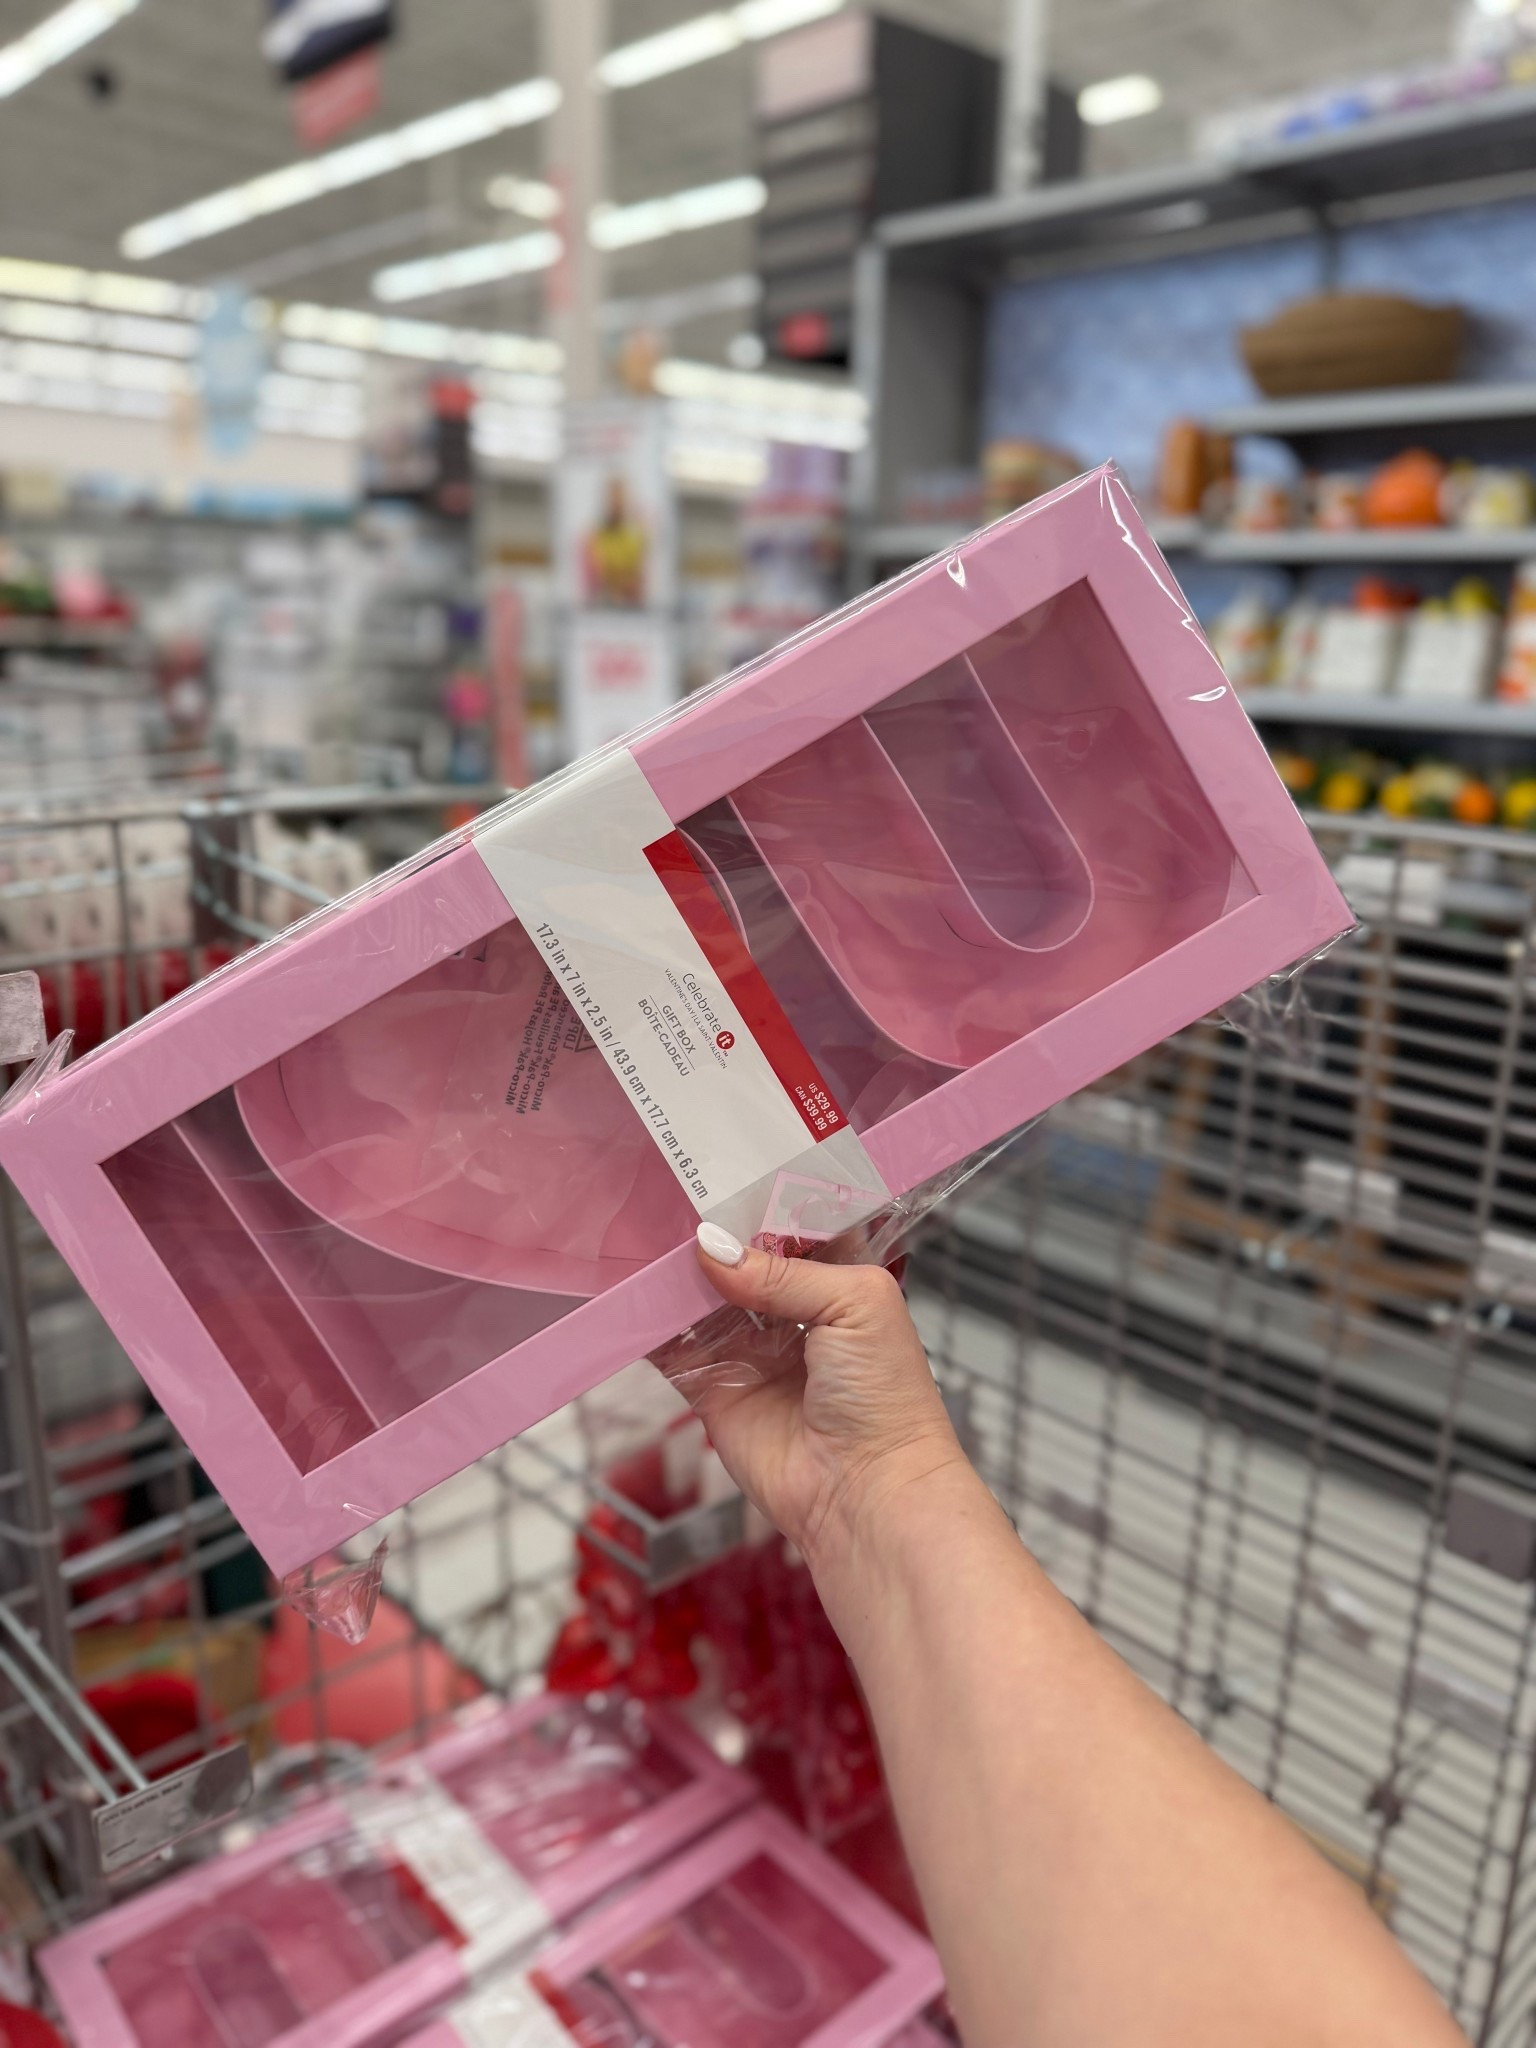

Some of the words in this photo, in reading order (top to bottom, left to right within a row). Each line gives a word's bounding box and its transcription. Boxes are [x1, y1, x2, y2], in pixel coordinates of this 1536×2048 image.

[536, 922, 560, 949] 17.3
[551, 948, 566, 964] in
[560, 963, 572, 974] x
[566, 971, 581, 982] 7
[572, 982, 587, 998] in
[580, 997, 592, 1007] x
[682, 973, 722, 1033] Celebrate
[586, 1005, 608, 1028] 2.5
[684, 1002, 696, 1015] DAY
[694, 1018, 703, 1027] LA
[599, 1026, 613, 1041] in
[638, 998, 690, 1076] BOÎTE-CADEAU
[662, 1005, 682, 1028] GIFT
[676, 1030, 696, 1054] BOX
[613, 1048, 637, 1076] 43.9
[628, 1076, 646, 1096] cm
[640, 1094, 652, 1106] x
[794, 1086, 807, 1100] CAN
[803, 1098, 828, 1130] $39.99
[808, 1082, 818, 1094] US
[814, 1091, 838, 1124] $29.99
[647, 1104, 670, 1128] 17.7
[662, 1130, 679, 1150] cm
[673, 1149, 685, 1160] x
[679, 1157, 699, 1179] 6.3
[691, 1179, 709, 1199] cm
